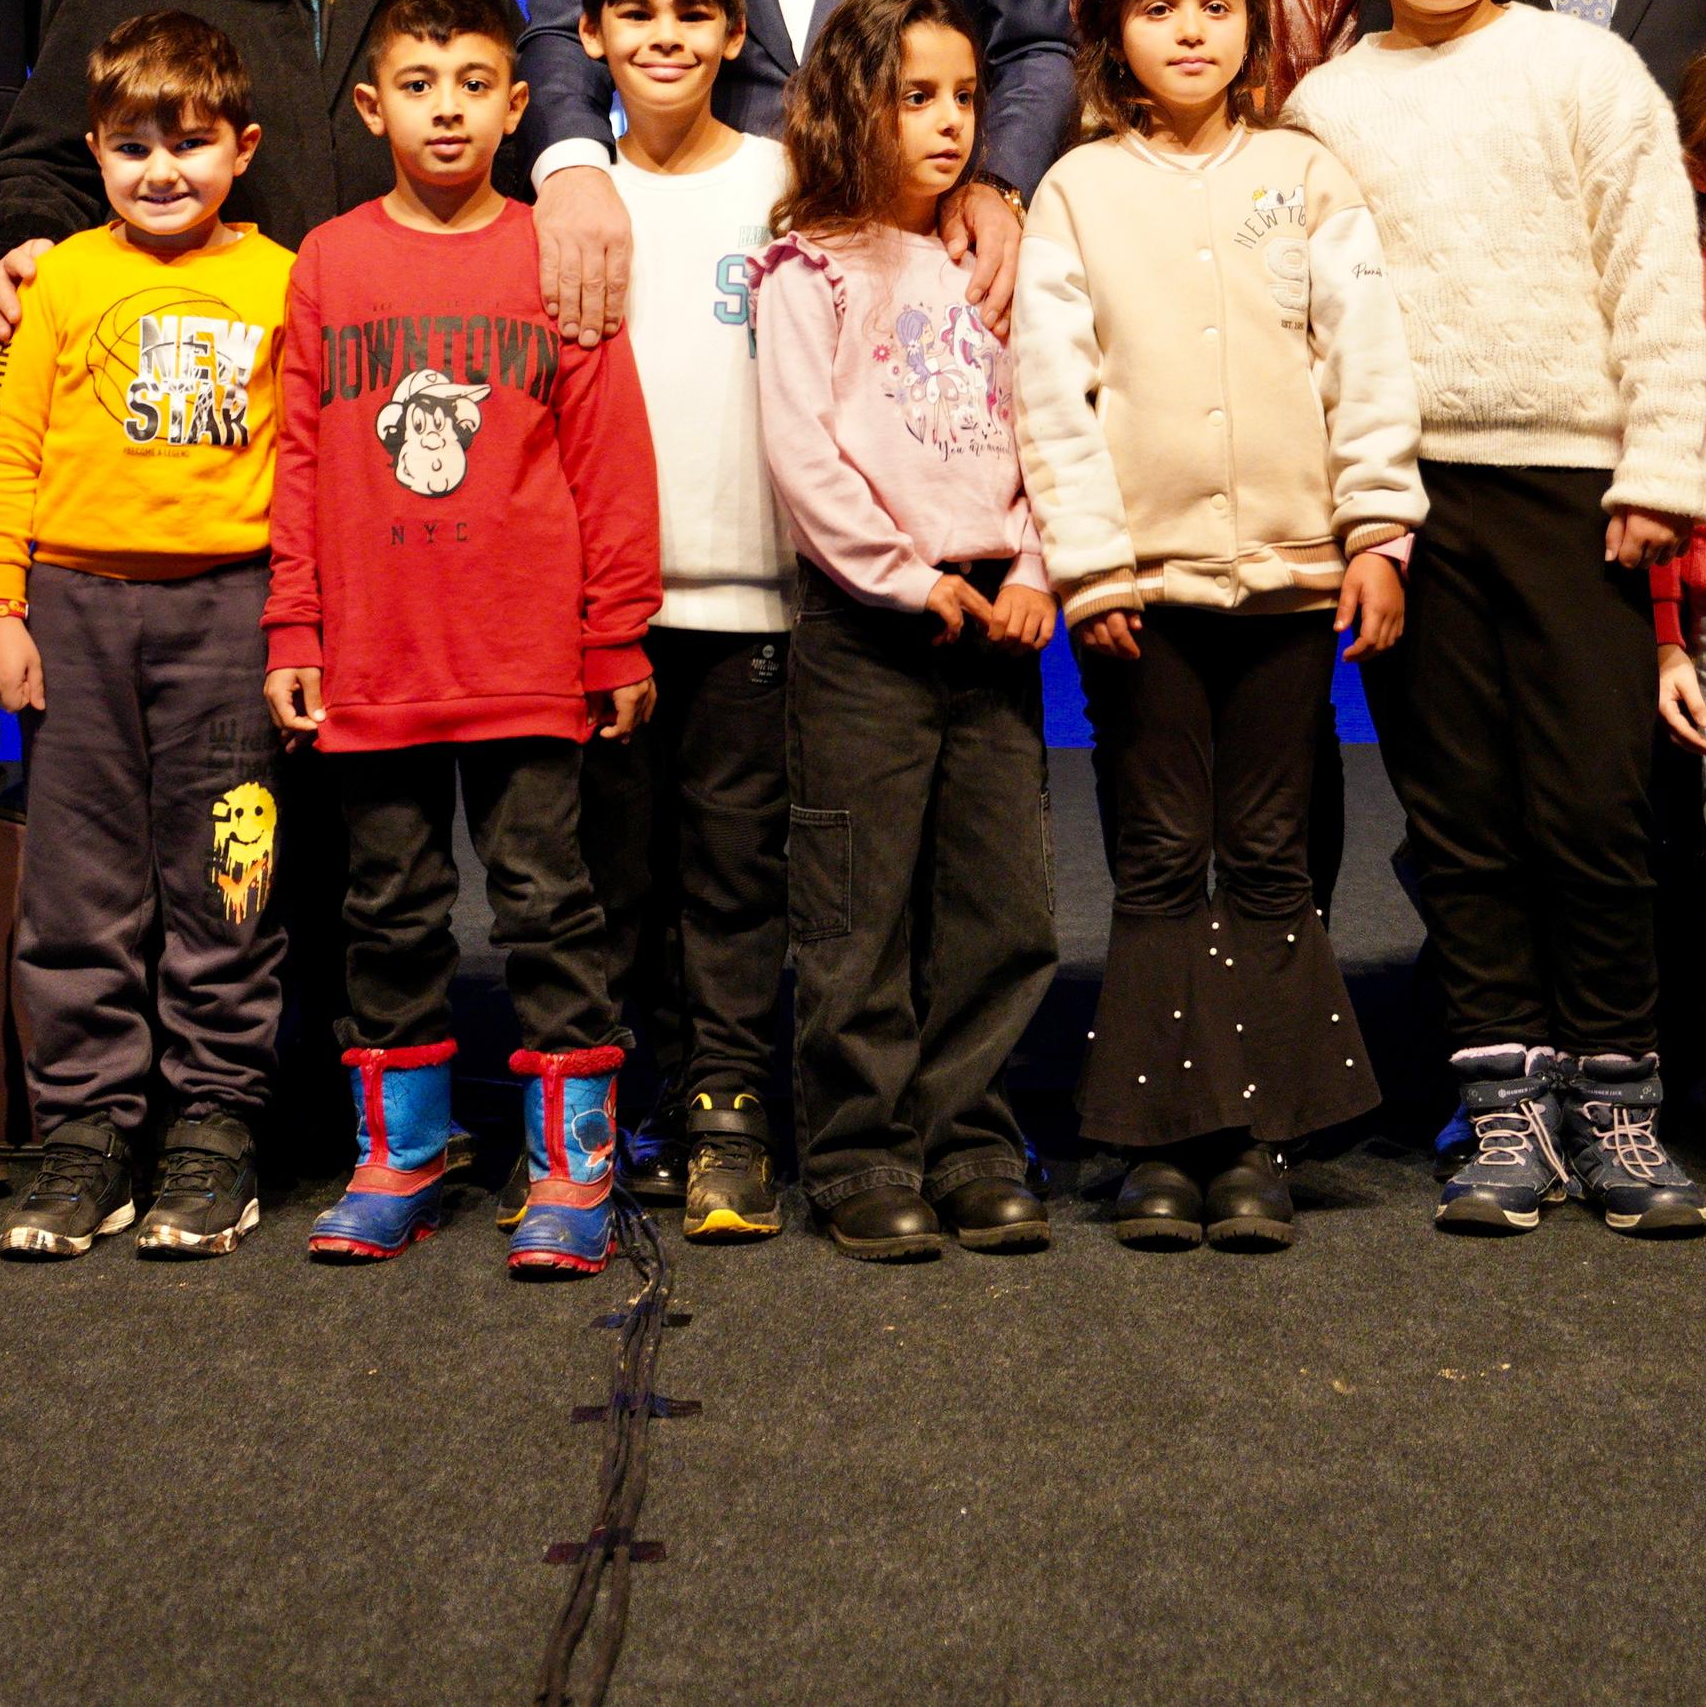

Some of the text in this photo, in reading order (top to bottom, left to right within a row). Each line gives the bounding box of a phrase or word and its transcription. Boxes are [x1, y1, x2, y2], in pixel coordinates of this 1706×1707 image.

[1234, 209, 1278, 249] NEW
[138, 314, 265, 389] NEW
[320, 314, 561, 407] DOWNTOWN
[123, 375, 250, 447] STAR
